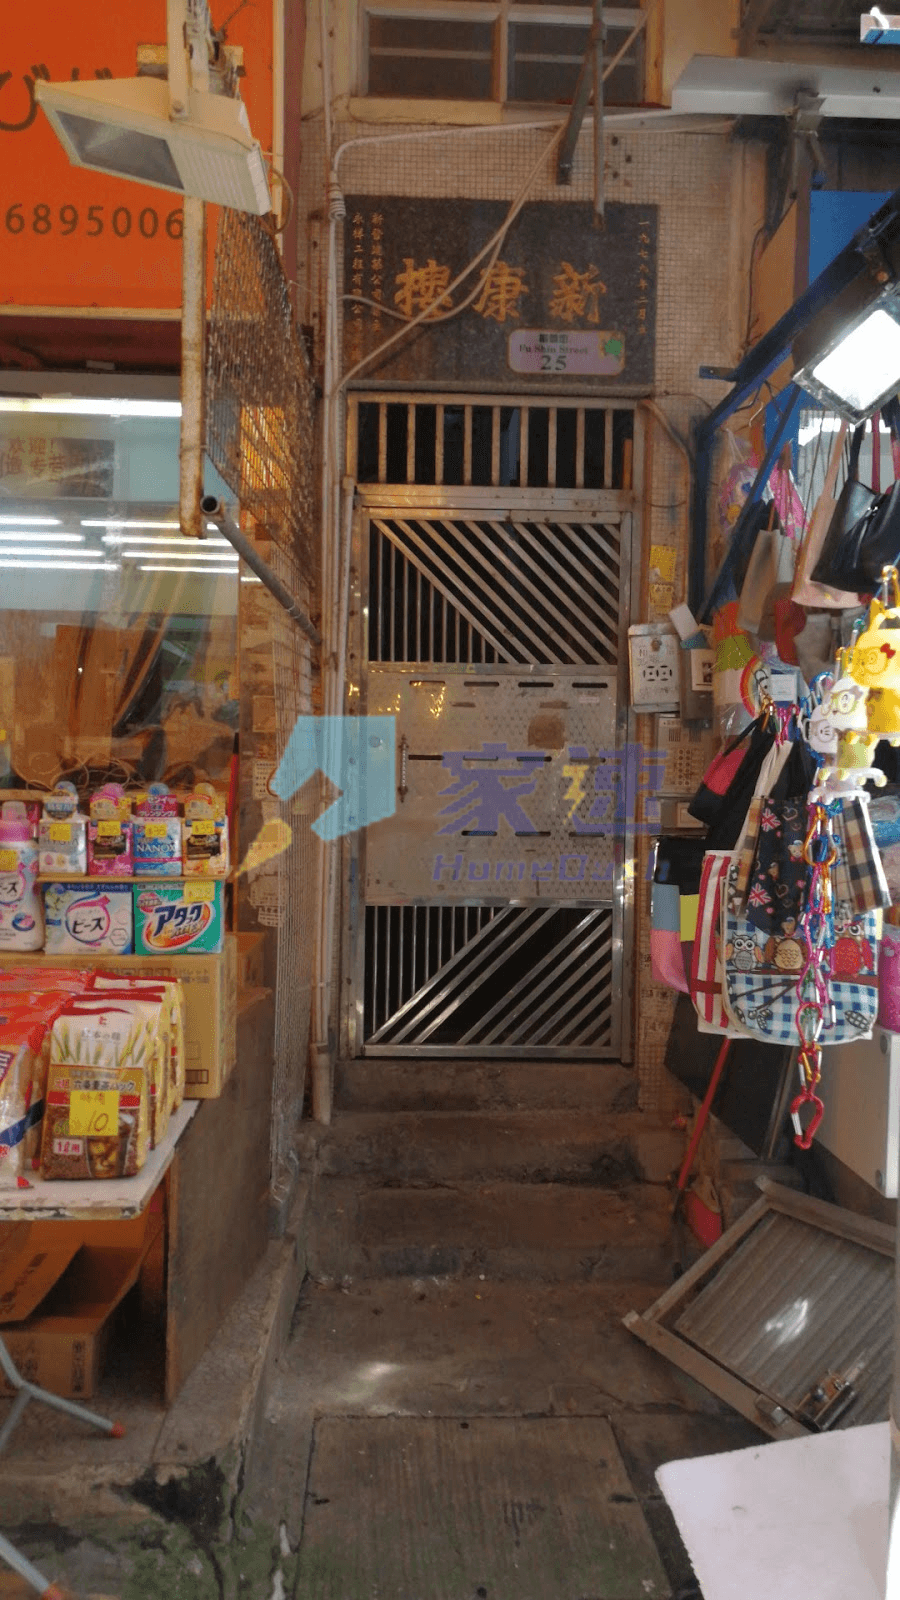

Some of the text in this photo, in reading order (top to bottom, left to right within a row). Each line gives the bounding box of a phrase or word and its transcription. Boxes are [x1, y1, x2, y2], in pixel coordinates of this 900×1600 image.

[5, 203, 184, 240] 6895006
[559, 345, 589, 355] Street
[540, 355, 567, 371] 25
[136, 843, 176, 853] NANOX
[72, 916, 105, 935] ビーズ
[153, 904, 203, 937] アタック
